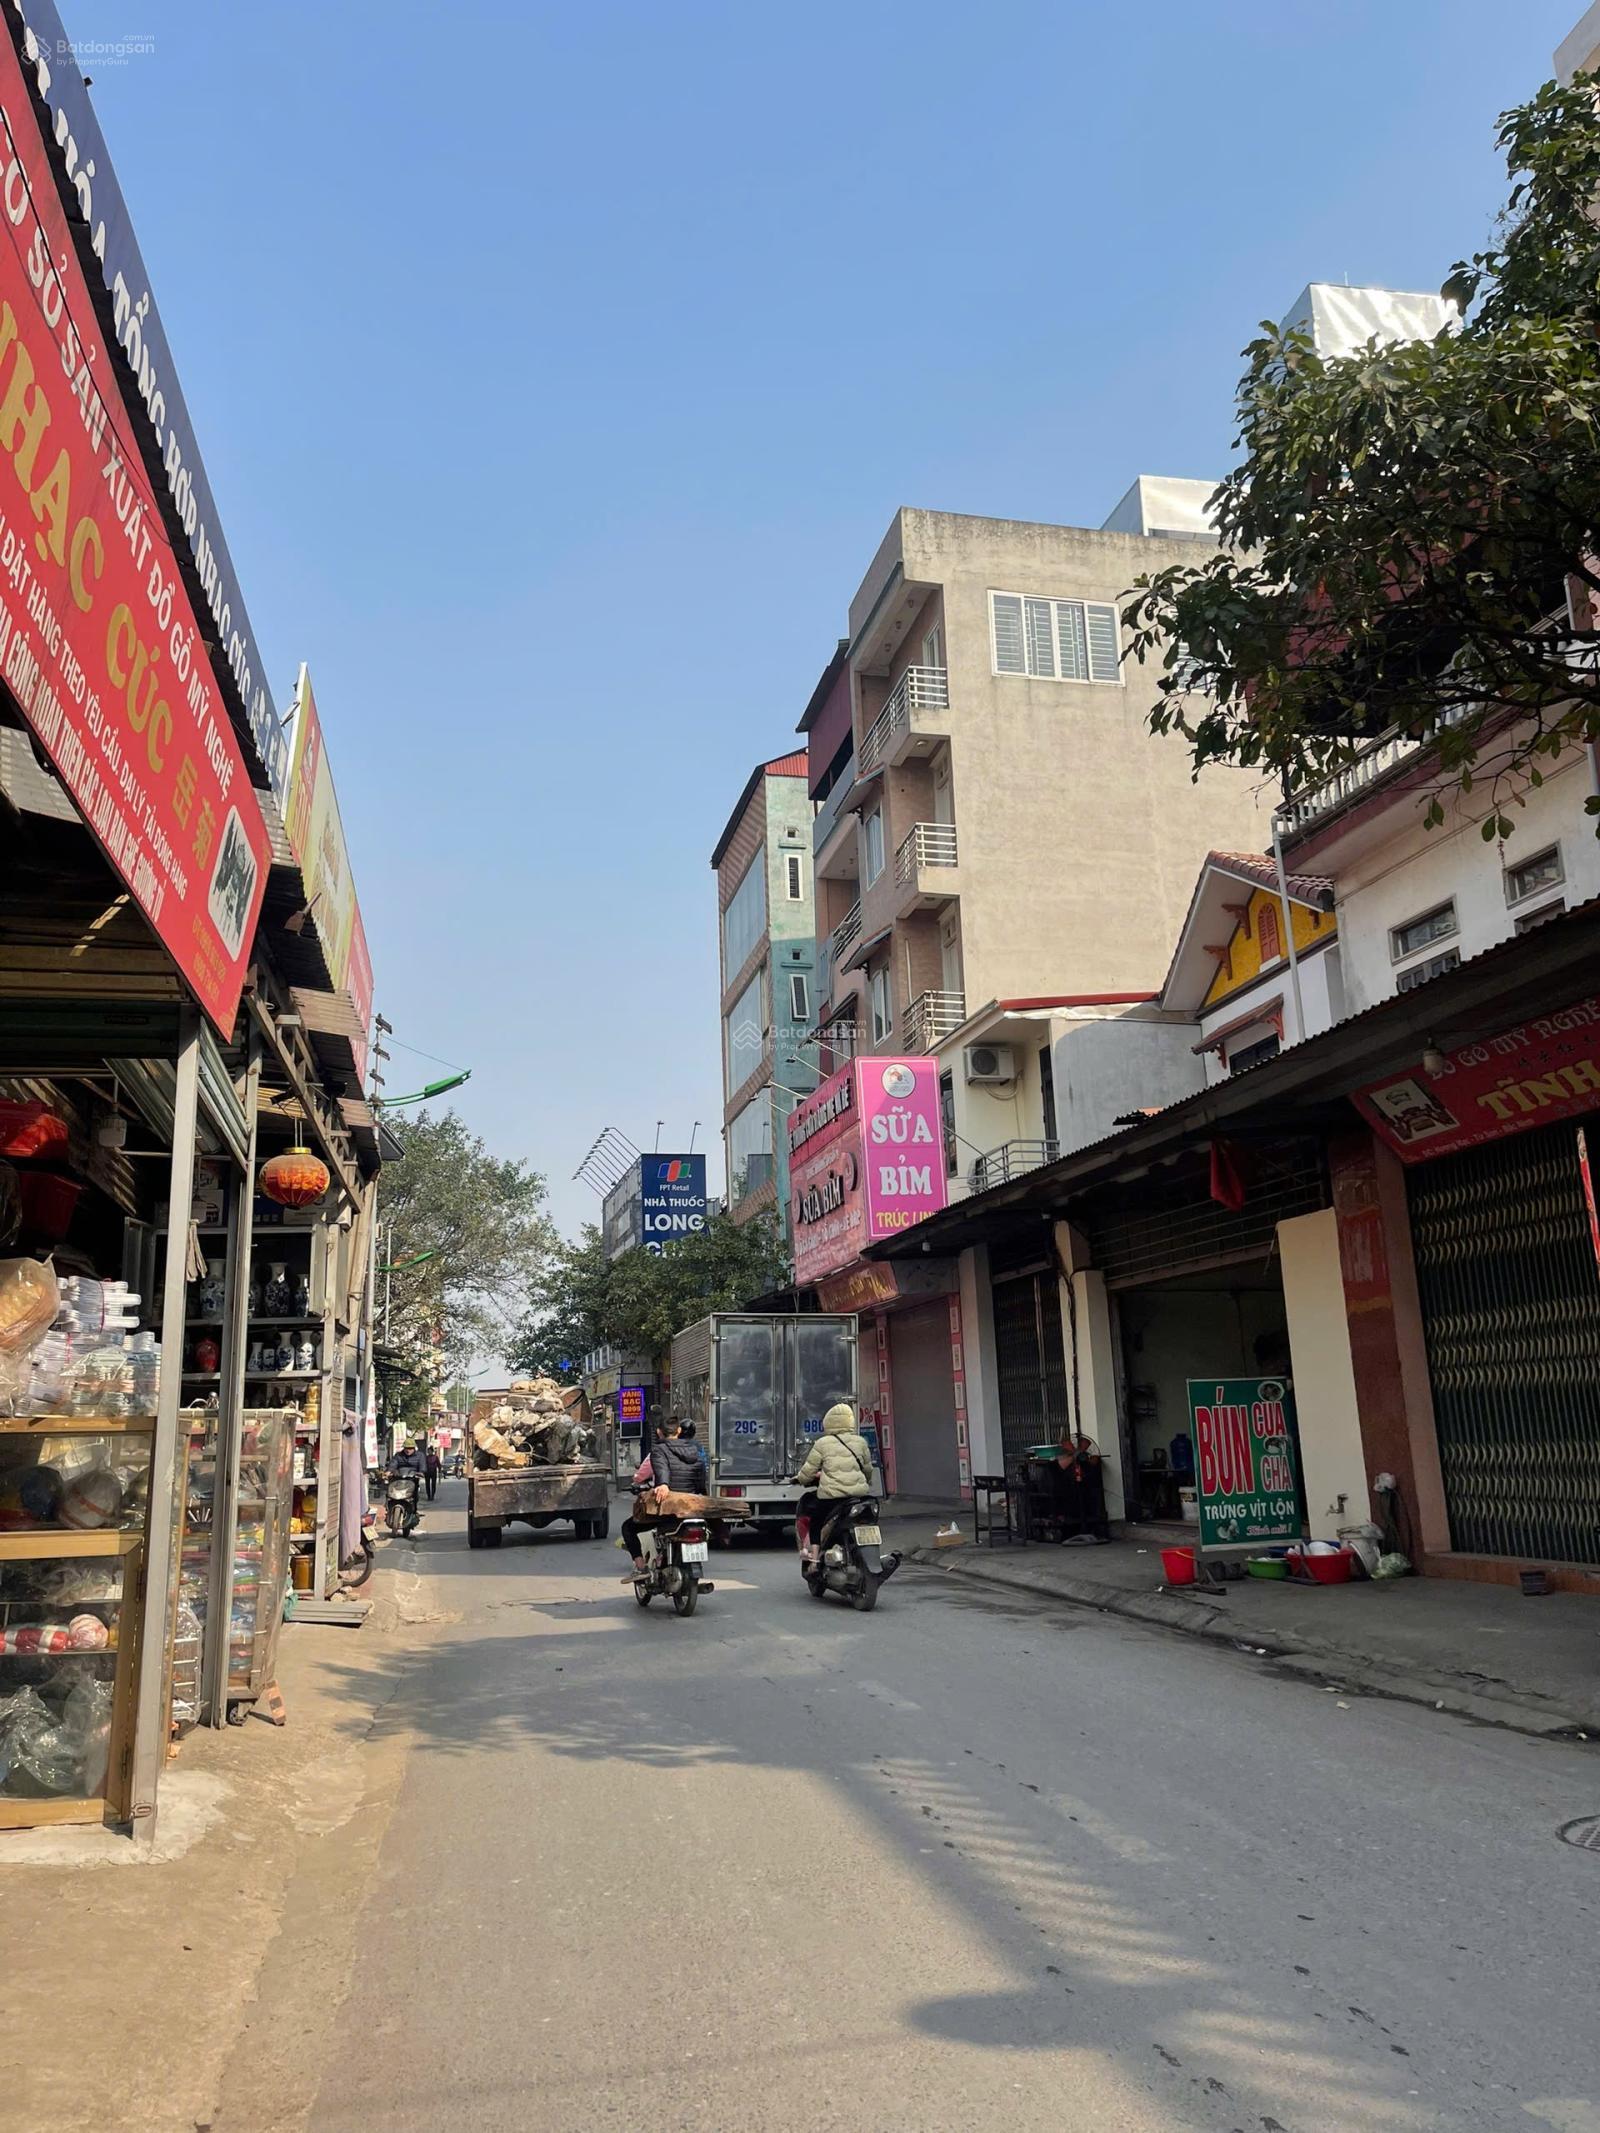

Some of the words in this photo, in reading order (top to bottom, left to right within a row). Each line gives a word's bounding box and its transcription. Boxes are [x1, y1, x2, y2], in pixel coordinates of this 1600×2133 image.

[0, 300, 105, 613] HẠC
[106, 603, 173, 774] CÚC
[62, 318, 109, 455] SẢN
[102, 437, 153, 572] XUẤT
[147, 560, 176, 631] ĐỒ
[169, 622, 195, 682] GỖ
[187, 668, 210, 729] MỸ
[204, 715, 234, 800] NGHỆ
[1, 528, 32, 596] ĐẶT
[27, 579, 61, 658] HÀNG
[59, 639, 86, 704] THEO
[84, 688, 104, 739] YÊU
[5, 630, 40, 711] CÔNG
[31, 675, 64, 751] HOÀN
[55, 716, 86, 788] THIỆN
[77, 757, 101, 814] CÁC
[92, 782, 116, 840] LOẠI
[871, 1105, 933, 1144] SỮA
[879, 1154, 933, 1196] BỈM
[644, 1195, 667, 1207] NHÀ
[669, 1195, 705, 1207] THUỐC
[876, 1208, 910, 1228] TRÚC
[644, 1213, 705, 1231] LONG
[1251, 1401, 1287, 1438] CUA
[1194, 1386, 1256, 1497] BÚN
[1204, 1501, 1247, 1520] TRỨNG
[1250, 1498, 1267, 1521] VỊT
[1270, 1498, 1295, 1520] LỘN
